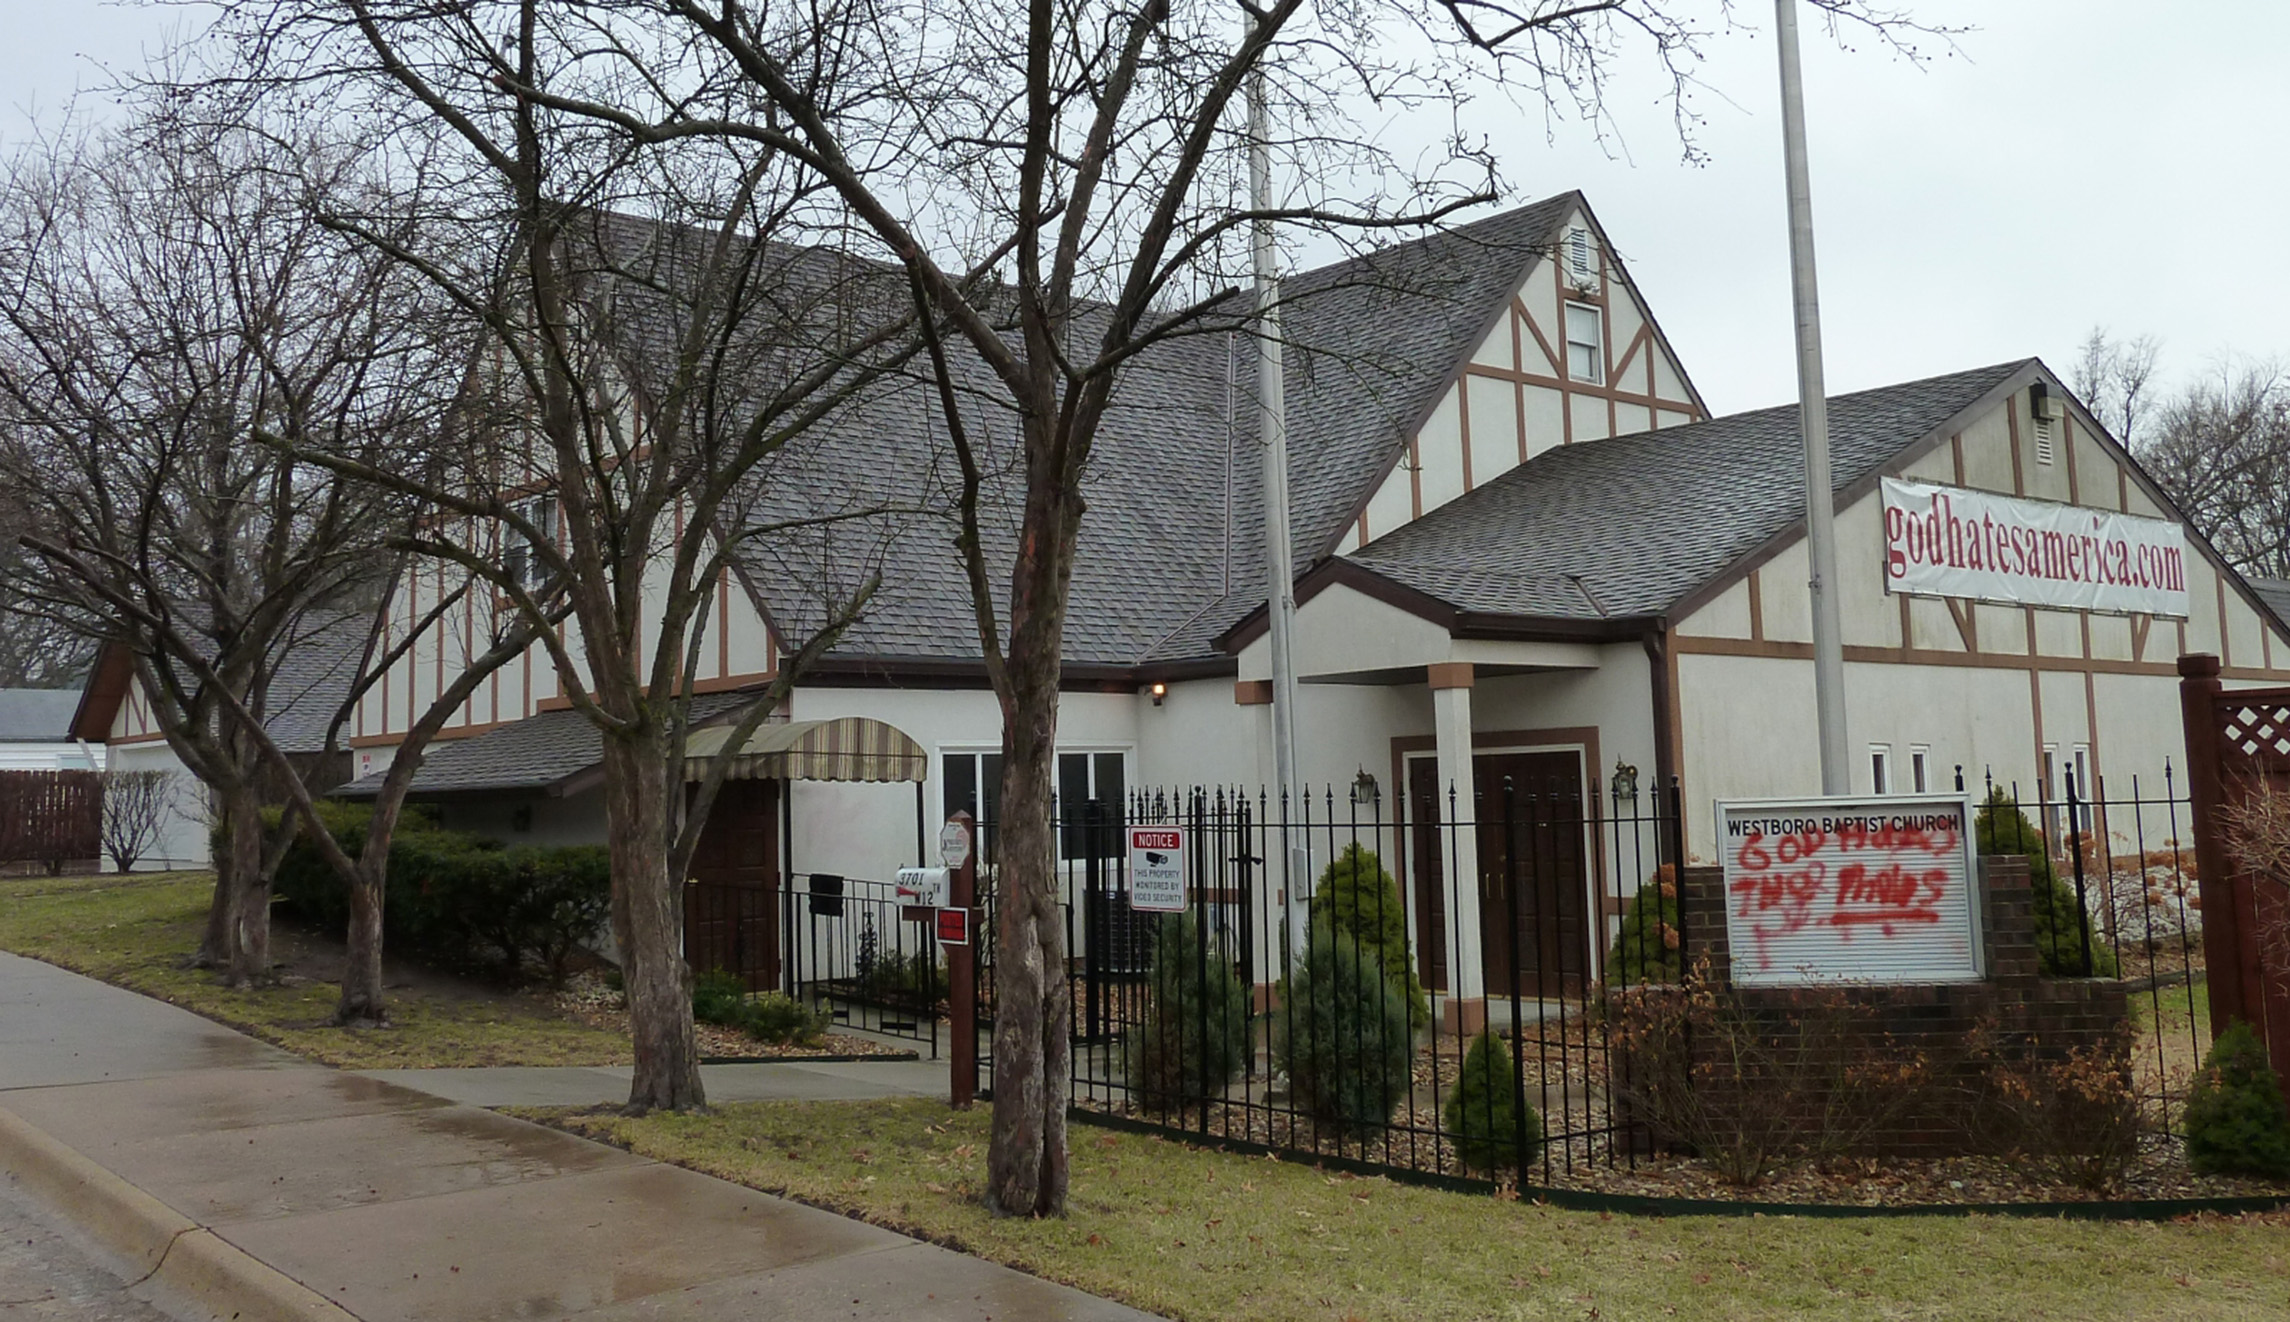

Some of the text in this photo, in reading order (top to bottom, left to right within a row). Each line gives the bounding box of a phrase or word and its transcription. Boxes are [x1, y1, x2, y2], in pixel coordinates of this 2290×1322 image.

[1885, 492, 2186, 592] godhatesamerica.com
[1727, 814, 1959, 837] WESTBORO BAPTIST CHURCH
[1138, 834, 1174, 847] NOTICE
[898, 873, 925, 886] 3701
[1134, 869, 1180, 879] THIS PROPERTY
[1170, 882, 1180, 891] BY
[1153, 893, 1182, 903] SECURITY
